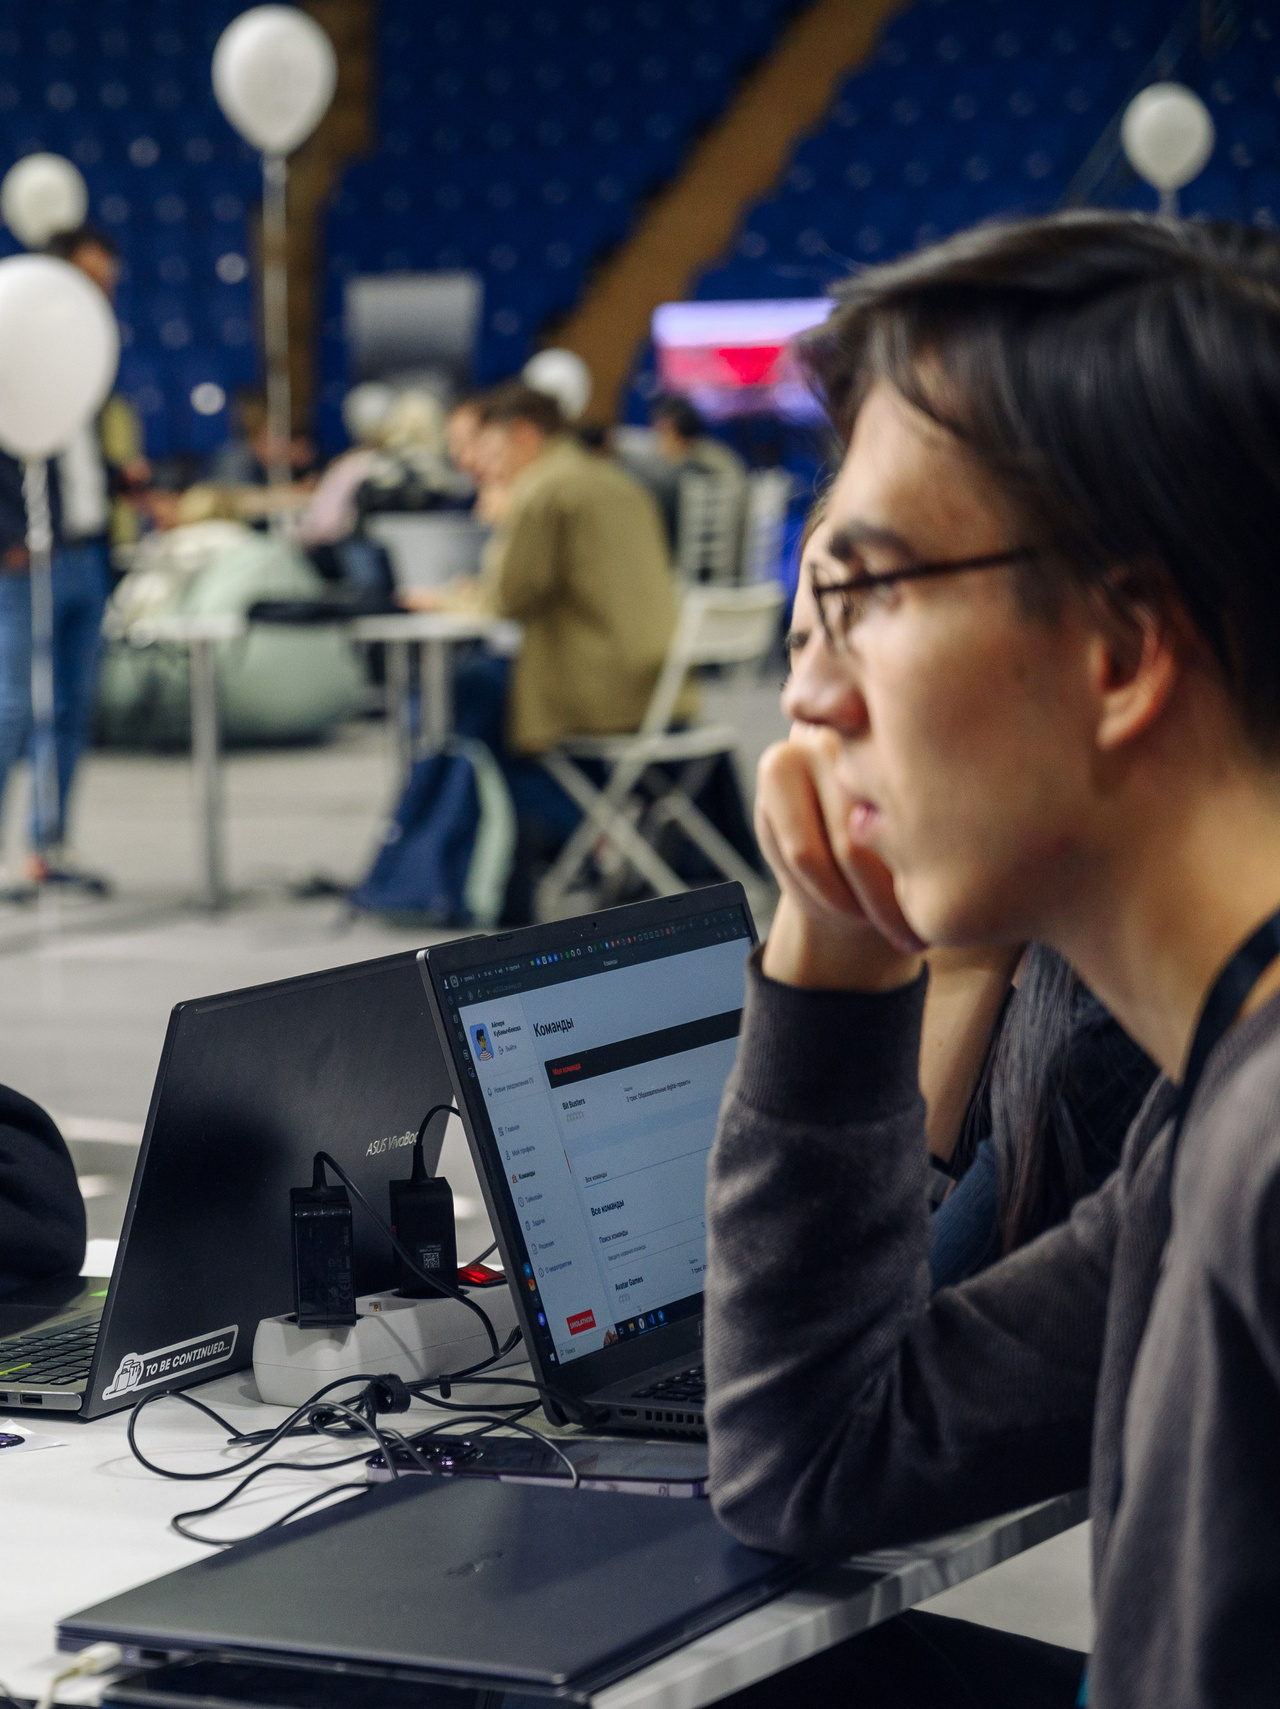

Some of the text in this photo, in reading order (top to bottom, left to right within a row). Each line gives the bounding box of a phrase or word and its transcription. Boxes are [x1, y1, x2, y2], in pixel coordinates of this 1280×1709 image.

[533, 1018, 575, 1037] Команды
[569, 1098, 586, 1109] Busters
[366, 1137, 388, 1157] ASUS
[590, 1199, 625, 1217] Все команды
[599, 1235, 611, 1244] Поиск
[615, 1276, 644, 1291] Avatar Games
[145, 1340, 230, 1377] TO BE CONTINUED...
